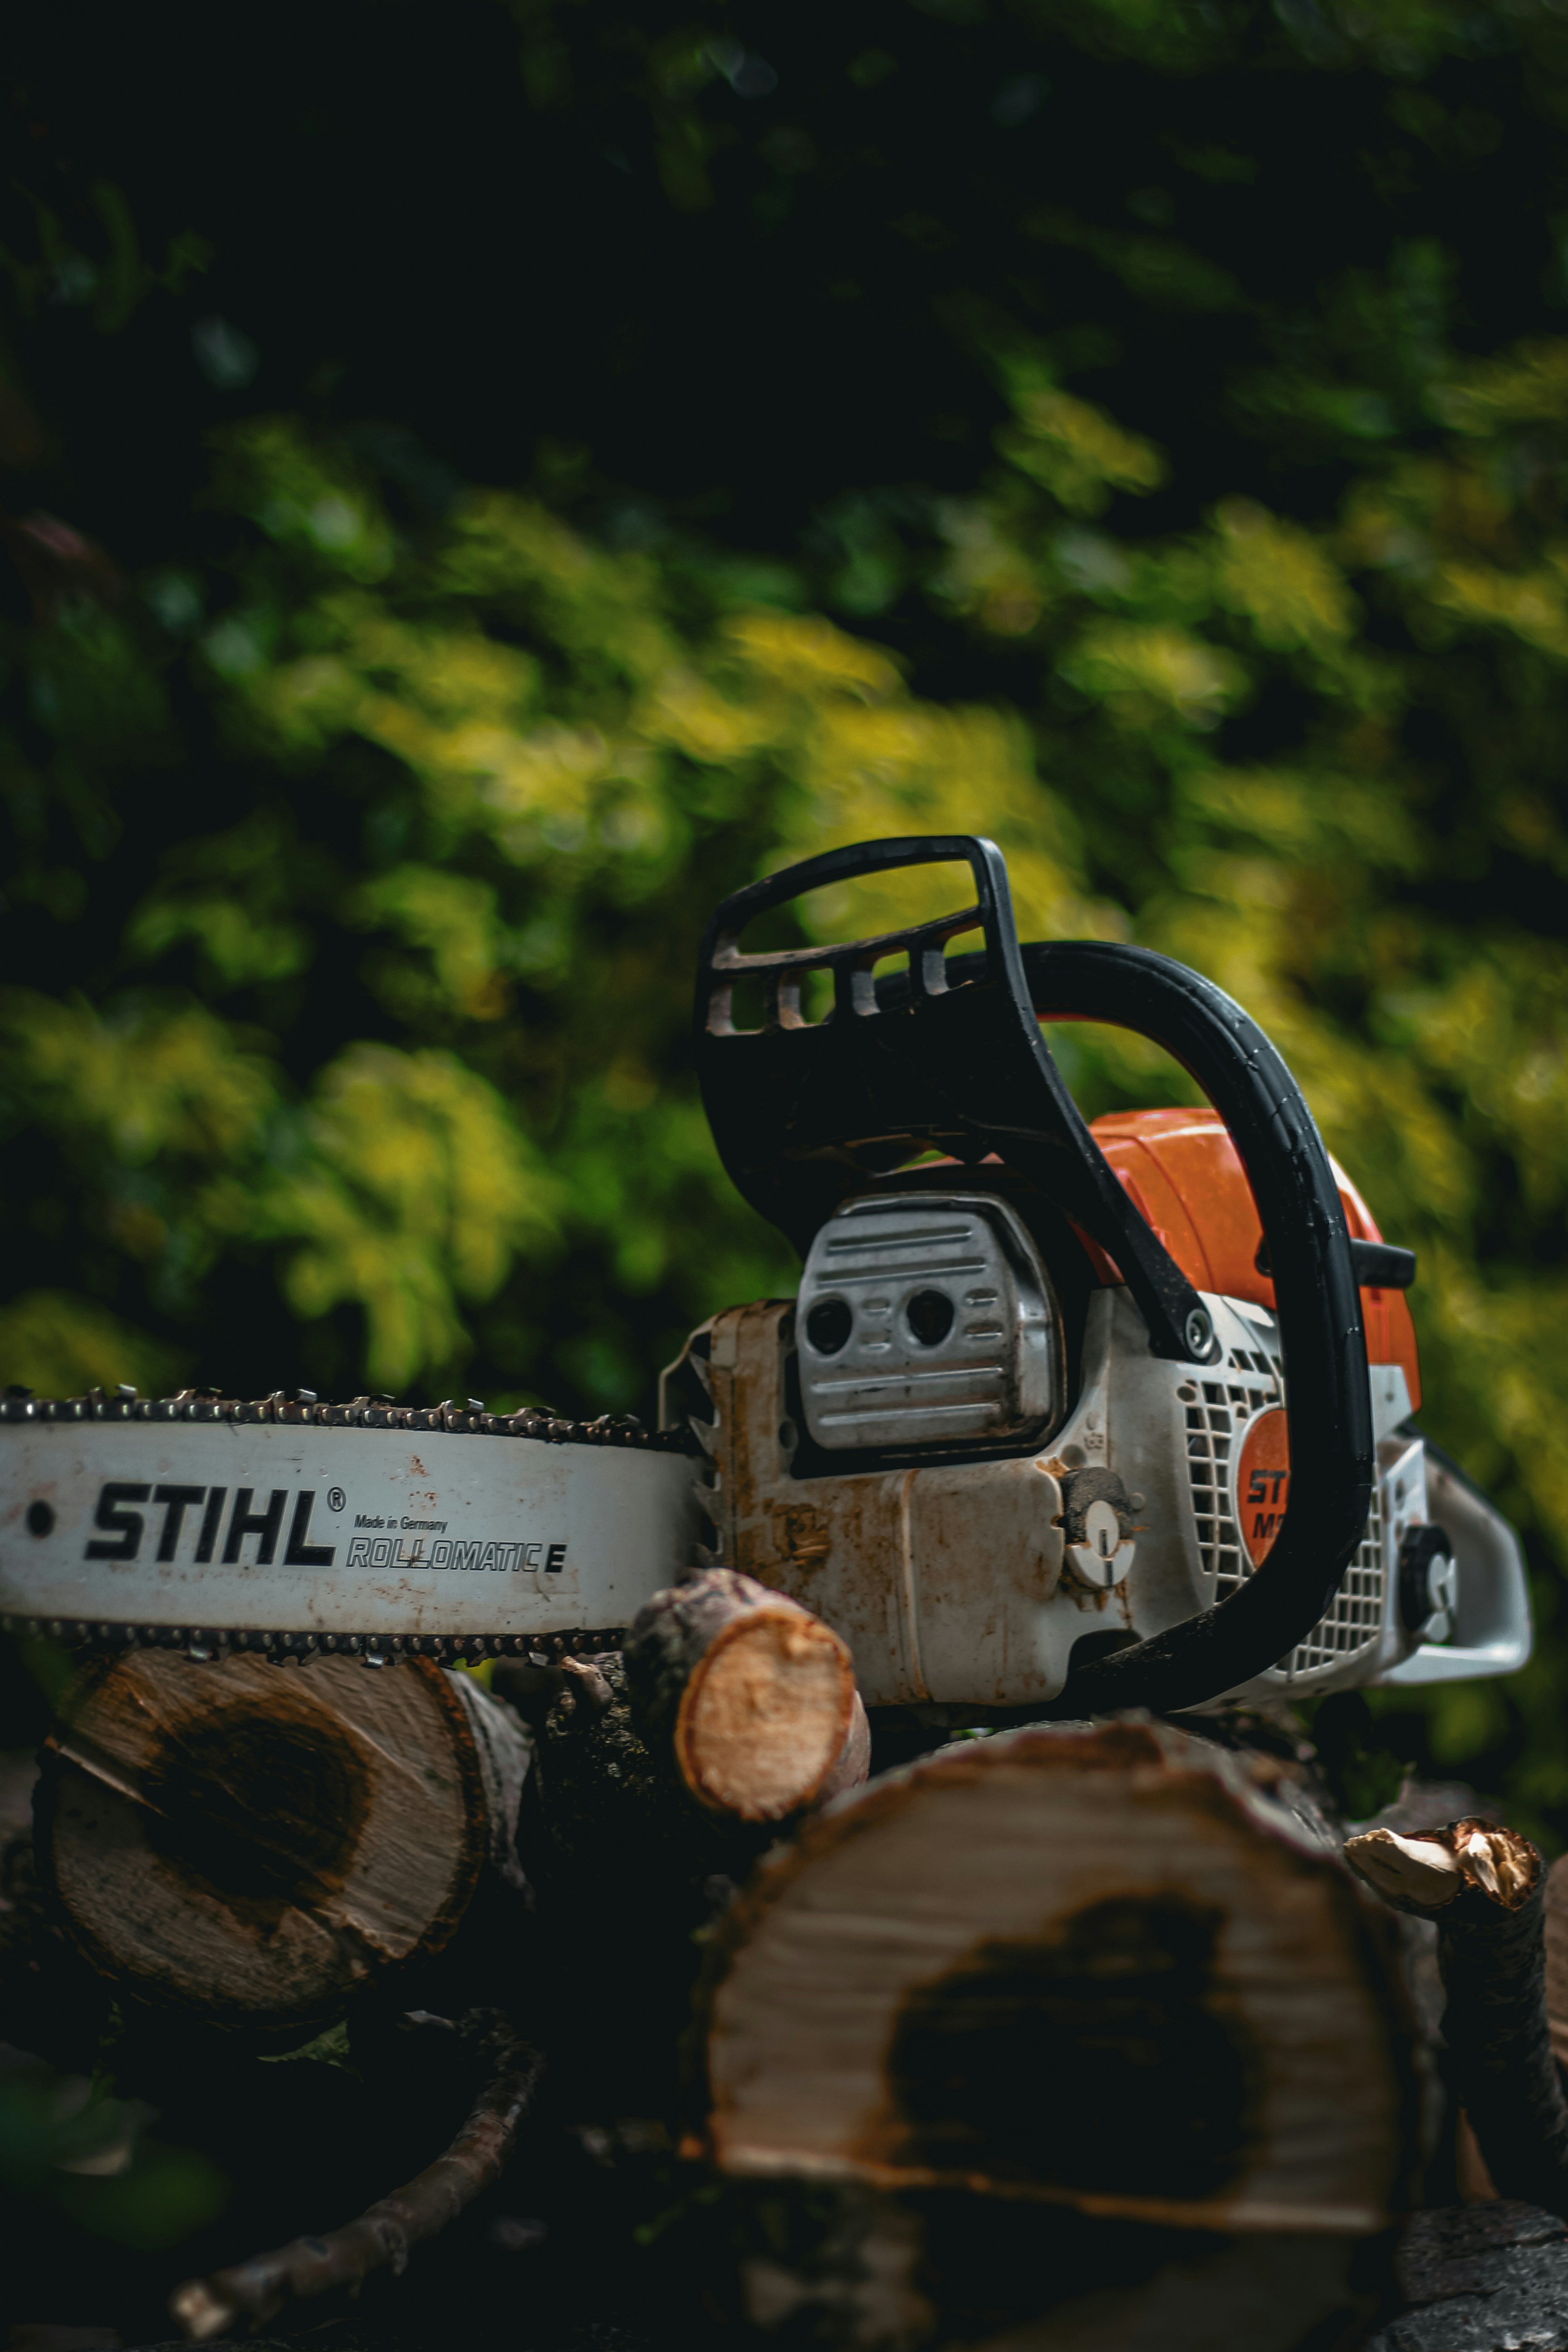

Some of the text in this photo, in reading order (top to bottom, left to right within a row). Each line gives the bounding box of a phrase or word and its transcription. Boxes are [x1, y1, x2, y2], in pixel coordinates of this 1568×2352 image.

[1247, 1470, 1288, 1504] ST
[354, 1514, 448, 1534] Made in Germany
[346, 1537, 567, 1573] ROLLOMATIC E
